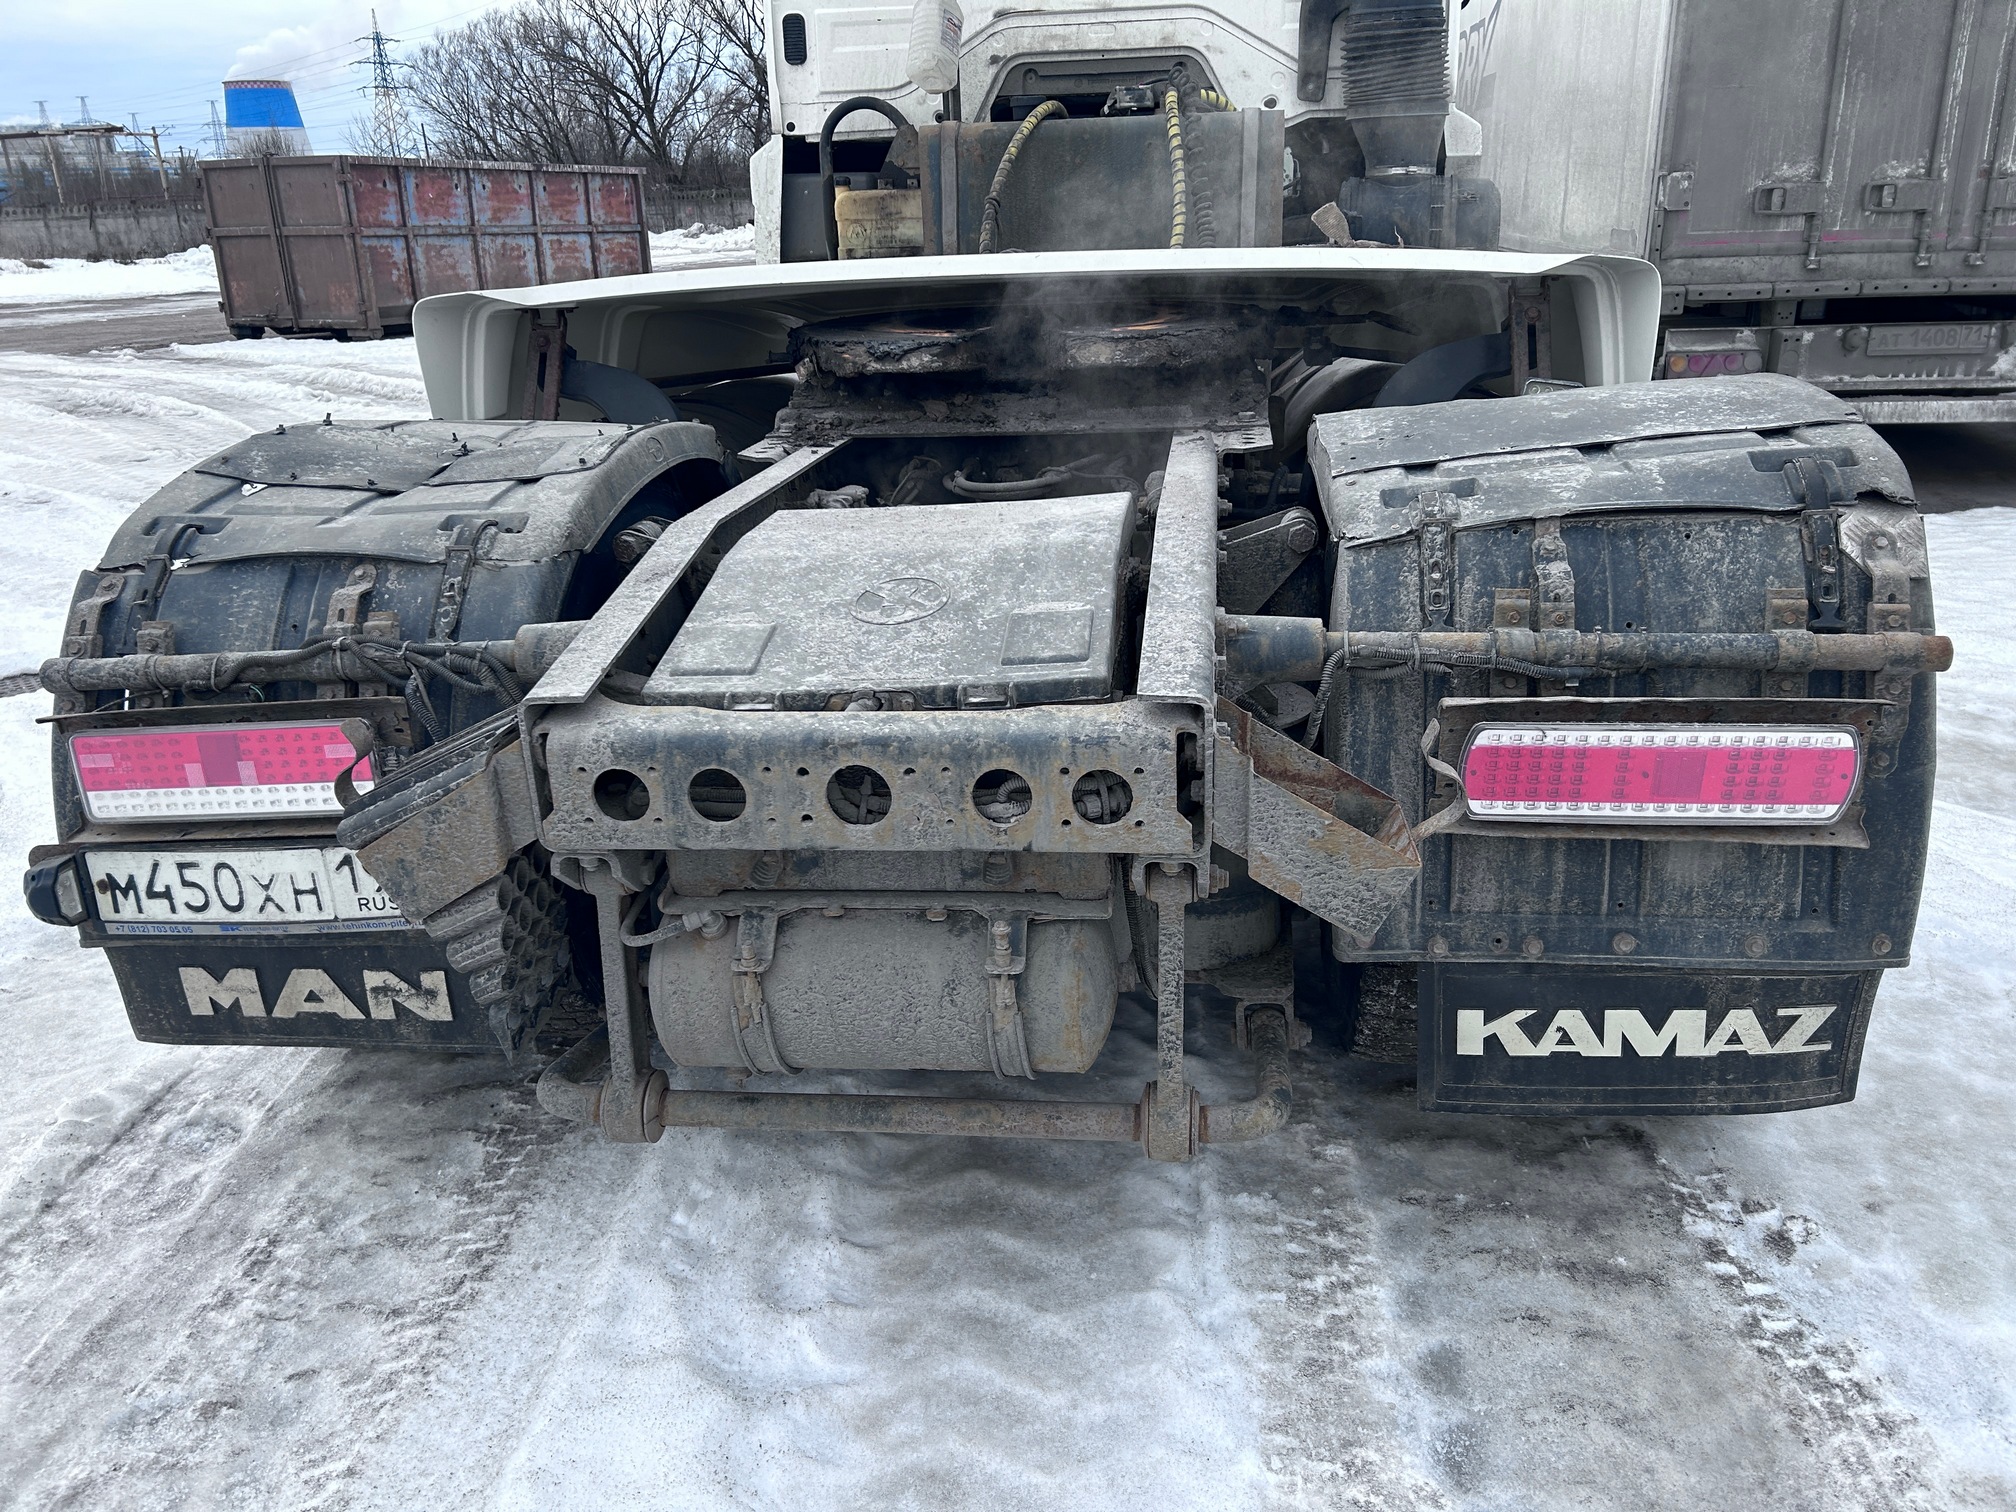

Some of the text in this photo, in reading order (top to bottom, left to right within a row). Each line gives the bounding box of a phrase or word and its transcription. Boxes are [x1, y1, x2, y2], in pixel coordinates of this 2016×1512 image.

[1909, 327, 1959, 347] 1408
[1963, 326, 1984, 341] 71
[115, 924, 125, 932] +7
[127, 924, 150, 933] (812)
[151, 925, 168, 933] 703
[169, 926, 181, 934] 05
[182, 926, 194, 934] 05
[178, 966, 454, 1022] MAN
[1456, 1004, 1838, 1057] KAMAZ
